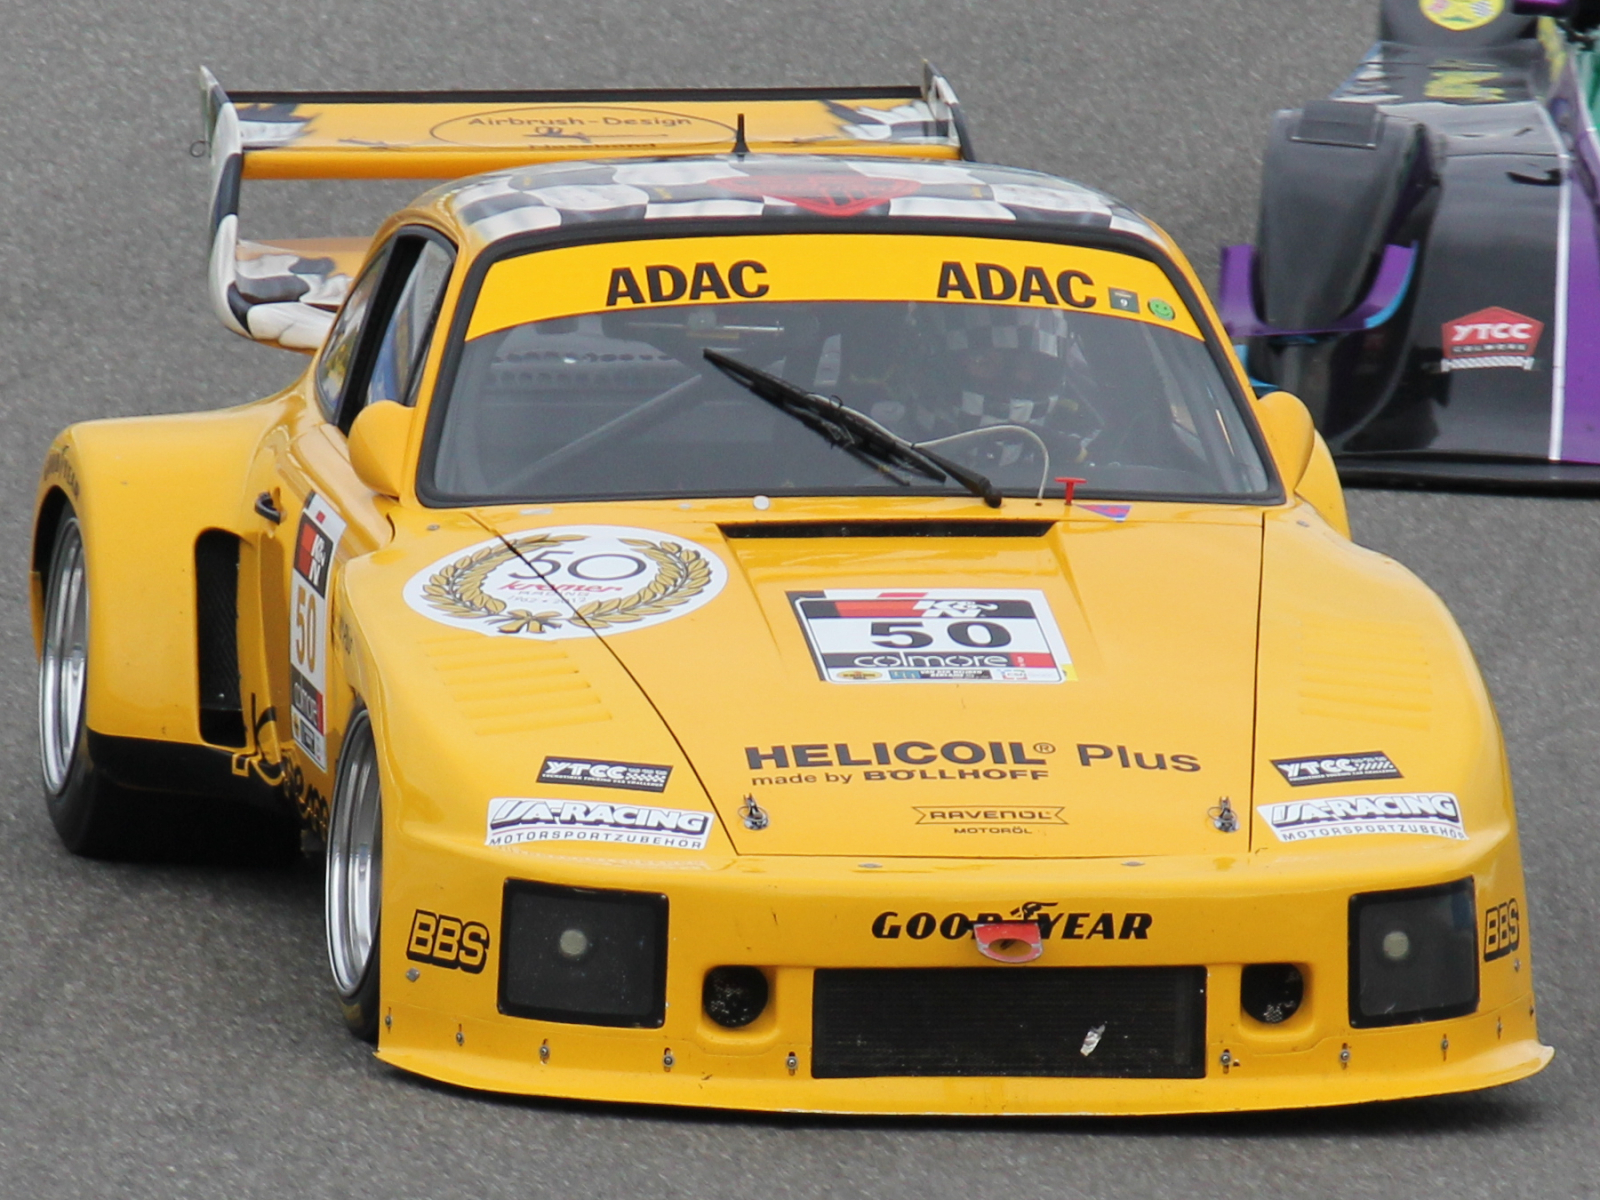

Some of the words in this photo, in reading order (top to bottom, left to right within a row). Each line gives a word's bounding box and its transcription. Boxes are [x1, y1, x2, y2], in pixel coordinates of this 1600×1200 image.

[605, 259, 770, 307] ADAC
[936, 261, 1097, 309] ADAC
[1451, 322, 1533, 342] YTCC
[507, 549, 647, 580] 50
[296, 583, 317, 674] 50
[870, 620, 1012, 649] 50
[853, 651, 1010, 668] colmore
[545, 760, 628, 780] YTCC
[1076, 743, 1201, 773] Plus
[1277, 758, 1357, 778] YTCC
[751, 772, 817, 786] made
[824, 772, 853, 785] by
[406, 908, 490, 975] BBS
[1484, 898, 1519, 963] BBS
